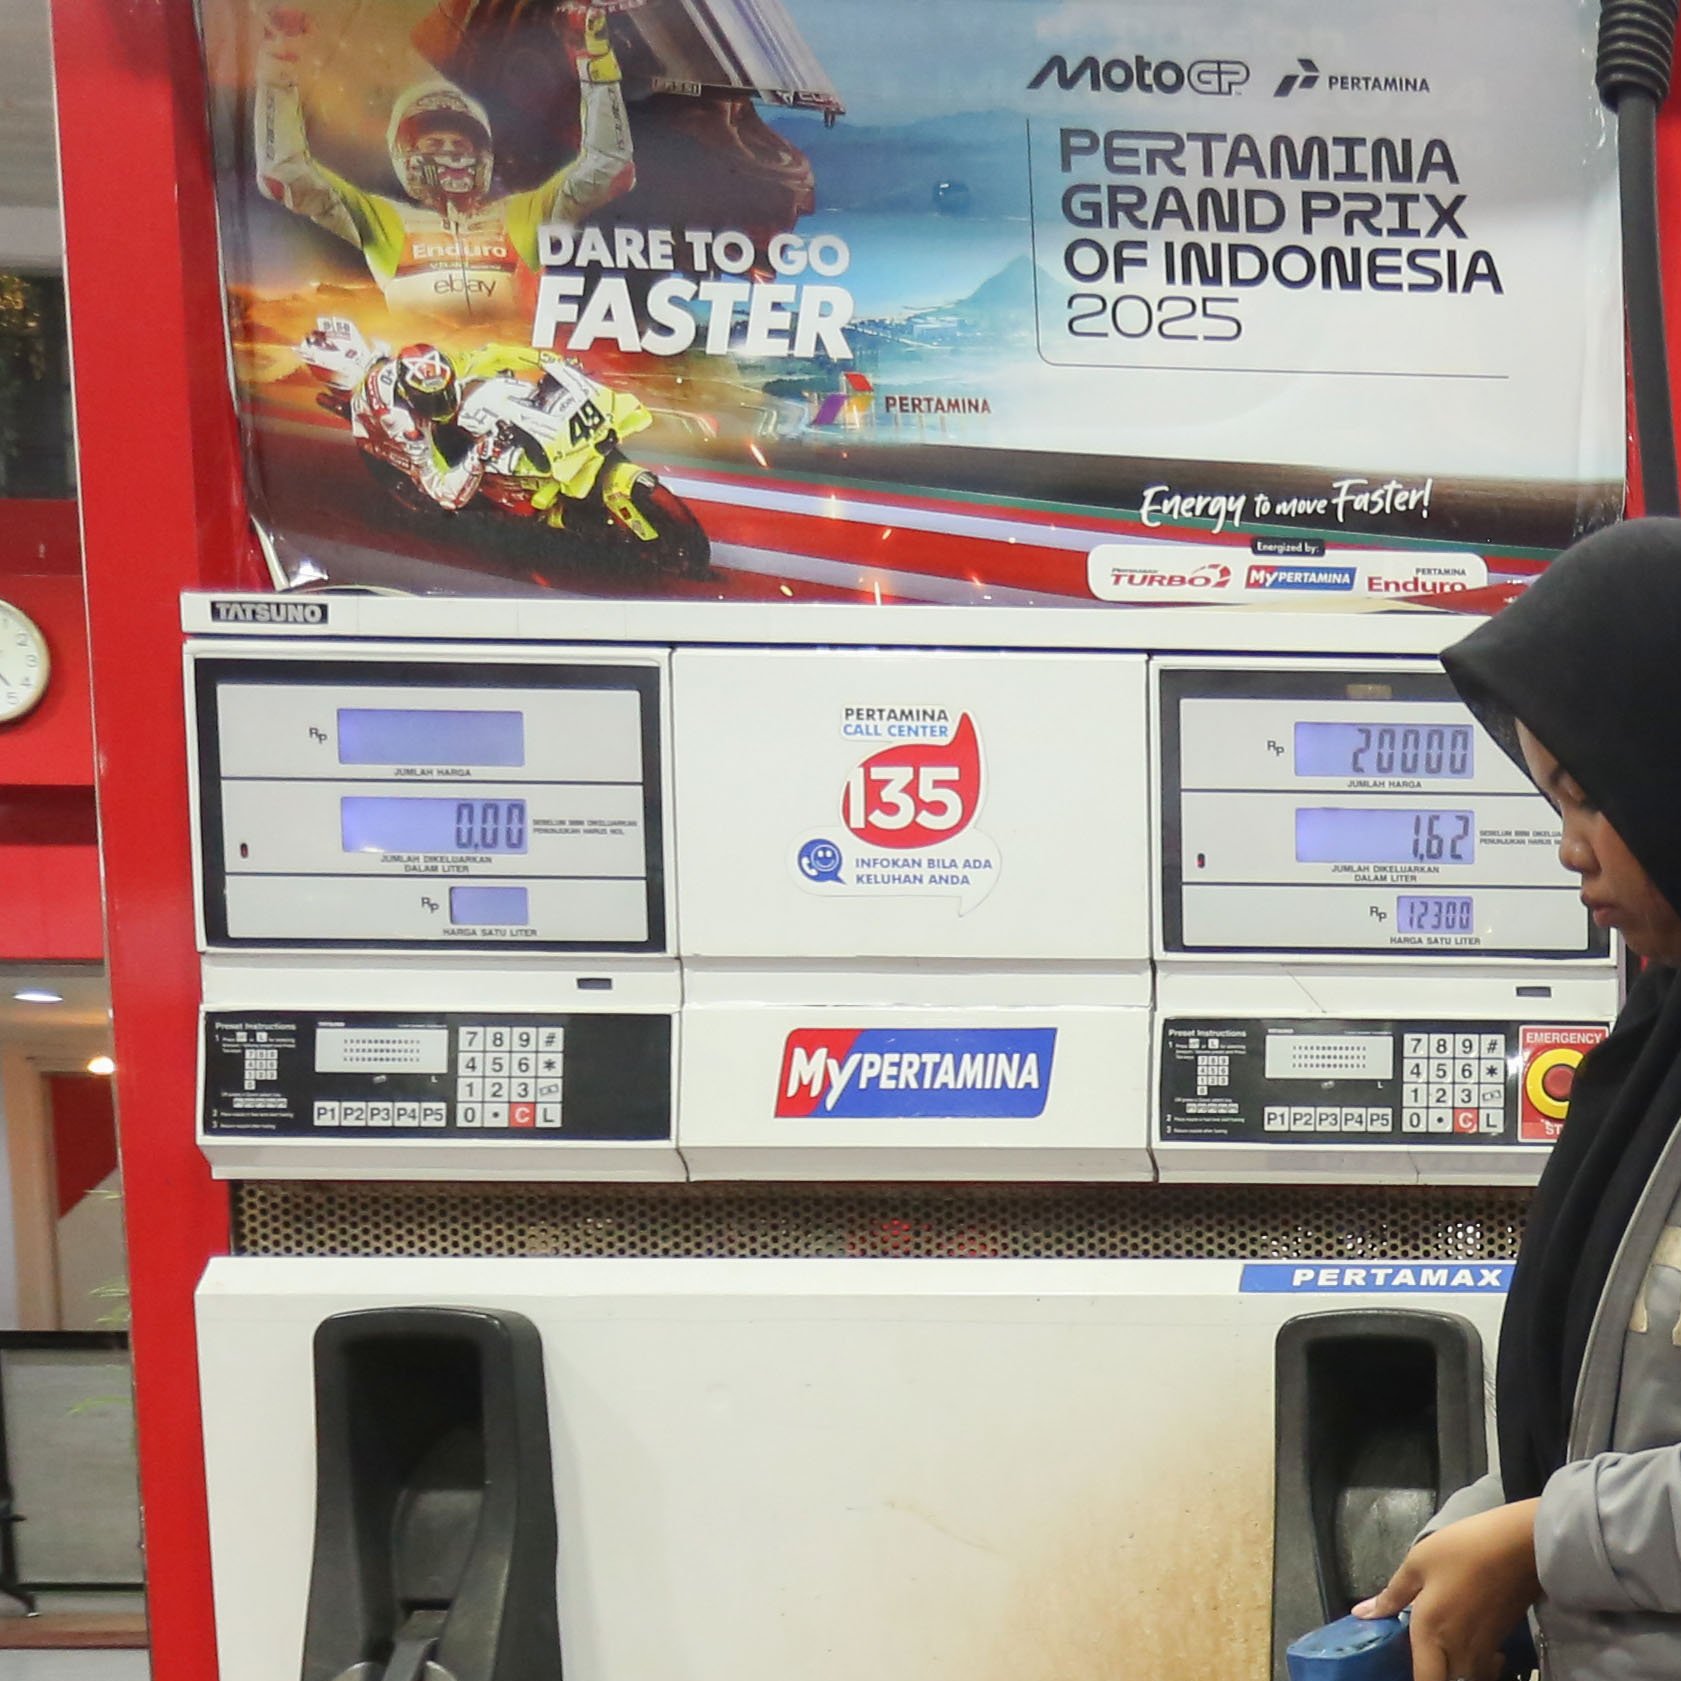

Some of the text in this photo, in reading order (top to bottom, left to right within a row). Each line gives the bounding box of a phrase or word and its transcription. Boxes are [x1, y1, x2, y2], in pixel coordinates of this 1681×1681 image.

[1026, 55, 1250, 97] MotoGP
[1328, 74, 1431, 94] PERTAMINA
[1061, 127, 1461, 186] PERTAMINA
[1061, 183, 1469, 240] GRAND PRIX
[413, 243, 507, 260] Enduro
[537, 226, 850, 277] DARE TO GO
[1063, 238, 1504, 295] OF INDONESIA
[434, 275, 496, 297] ebay
[531, 275, 855, 360] FASTER
[1066, 293, 1243, 343] 2025
[885, 395, 991, 415] PERTAMINA
[568, 400, 605, 447] 49
[1139, 477, 1433, 534] Energy to move Faster!
[1256, 541, 1299, 554] Energized
[1247, 568, 1353, 588] MyPERTAMINA
[1415, 567, 1467, 576] PERTAMINA
[1111, 573, 1211, 588] TURBO
[1368, 576, 1467, 593] Enduro
[215, 603, 322, 623] TATSUNO
[845, 708, 949, 722] PERTAMINA
[843, 723, 949, 738] CALL CENTER
[1352, 728, 1469, 774] 20000
[394, 768, 471, 777] JUMLAH HARGA
[1347, 780, 1422, 789] JUMLAH HARGA
[847, 766, 963, 830] 135
[381, 855, 420, 864] JUMLAH
[856, 857, 993, 870] INFOKAN BILA ADA
[404, 865, 469, 873] DALAM LITER
[1331, 865, 1440, 874] JUMLAH DIKELUARKAN
[856, 874, 971, 886] KELUHAN ANDA
[1354, 874, 1417, 882] DALAM LITER
[1409, 901, 1471, 930] 12300
[443, 928, 537, 937] HARGA SATU LITER
[1390, 937, 1481, 946] HARGA SATU LITER
[1197, 1029, 1247, 1038] Instructions
[1526, 1032, 1602, 1044] EMERGENCY
[787, 1044, 1042, 1113] MyPERTAMINA
[1545, 1123, 1564, 1136] ST
[1293, 1269, 1503, 1287] PERTAMAX
